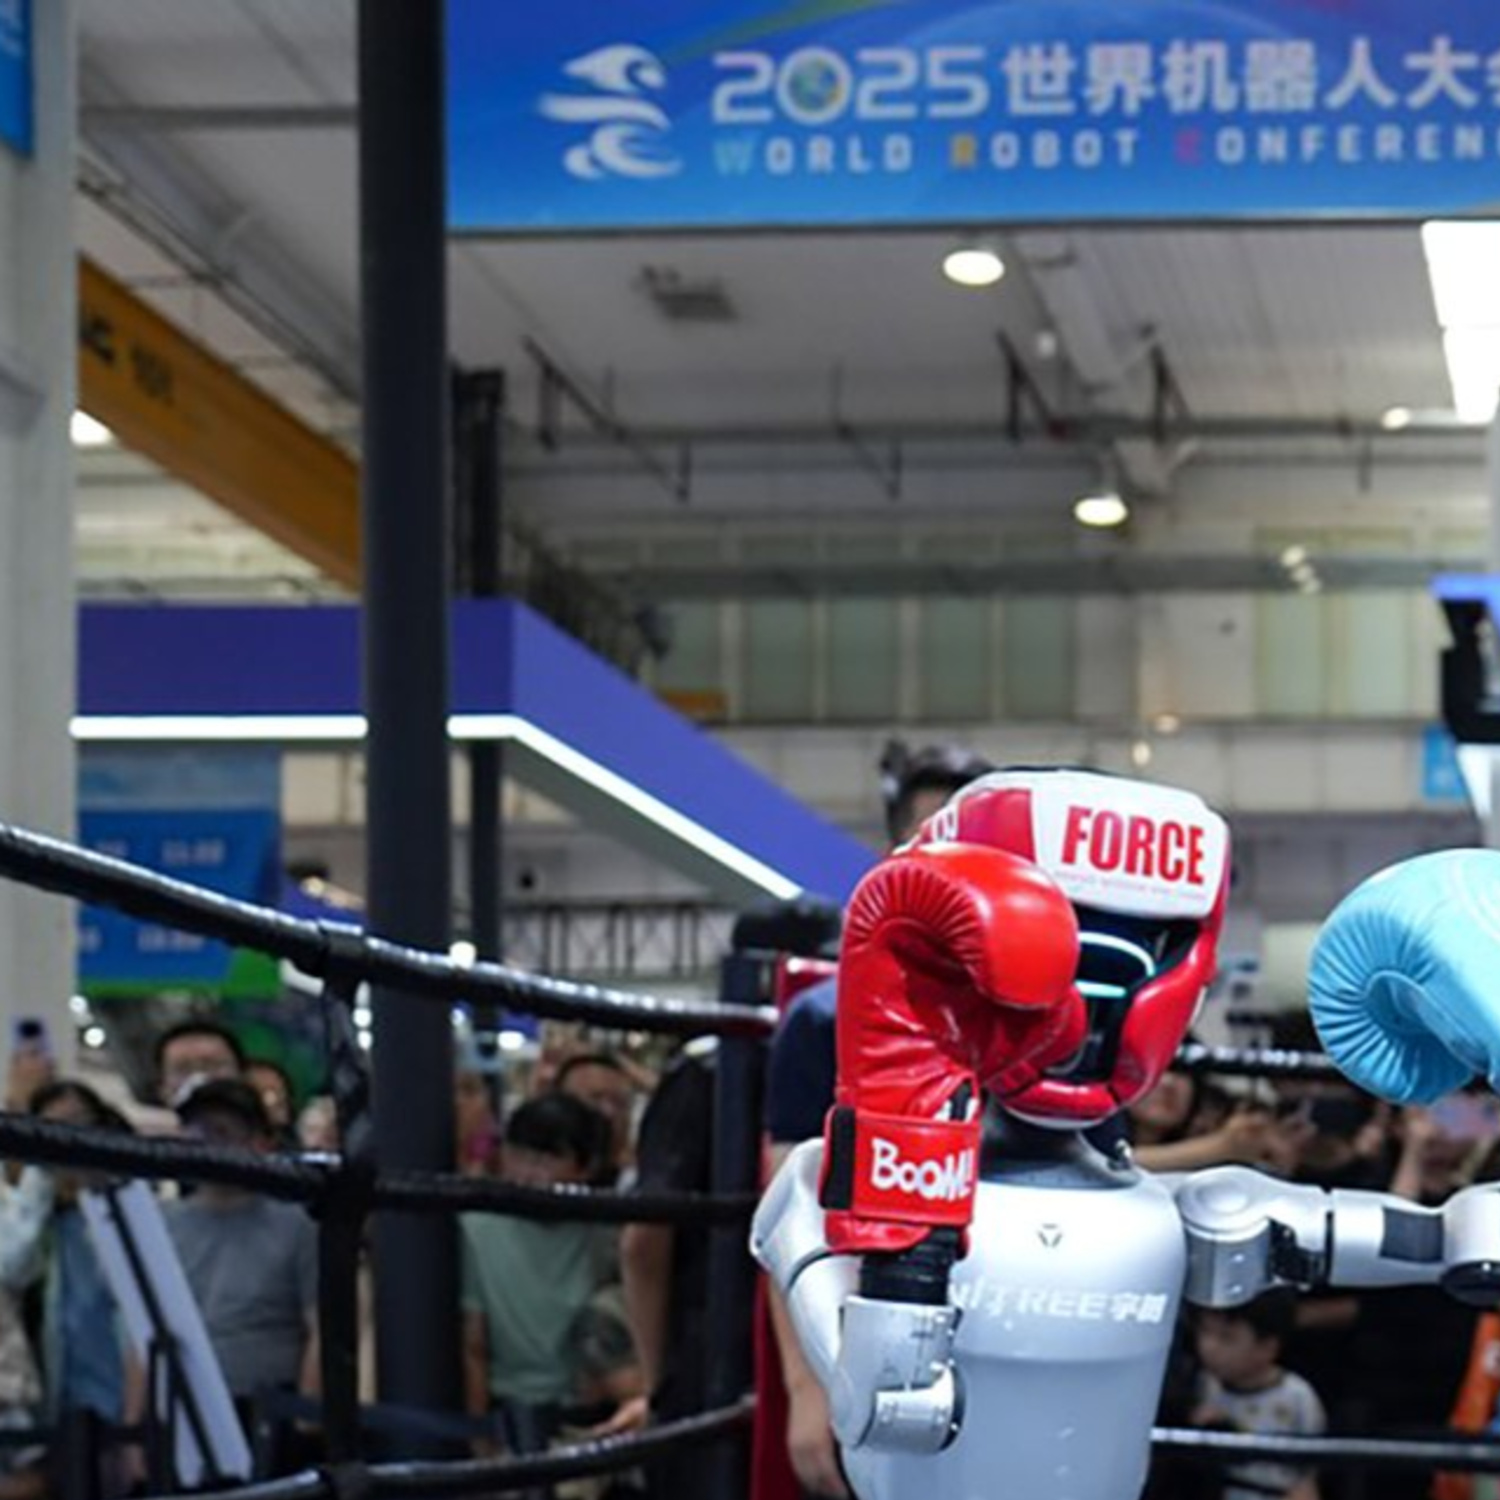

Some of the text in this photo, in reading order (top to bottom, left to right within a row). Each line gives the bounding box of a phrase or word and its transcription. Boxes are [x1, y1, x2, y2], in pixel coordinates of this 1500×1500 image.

[713, 133, 912, 175] WORLD
[950, 129, 1138, 171] ROBOT
[1061, 804, 1204, 885] FORCE
